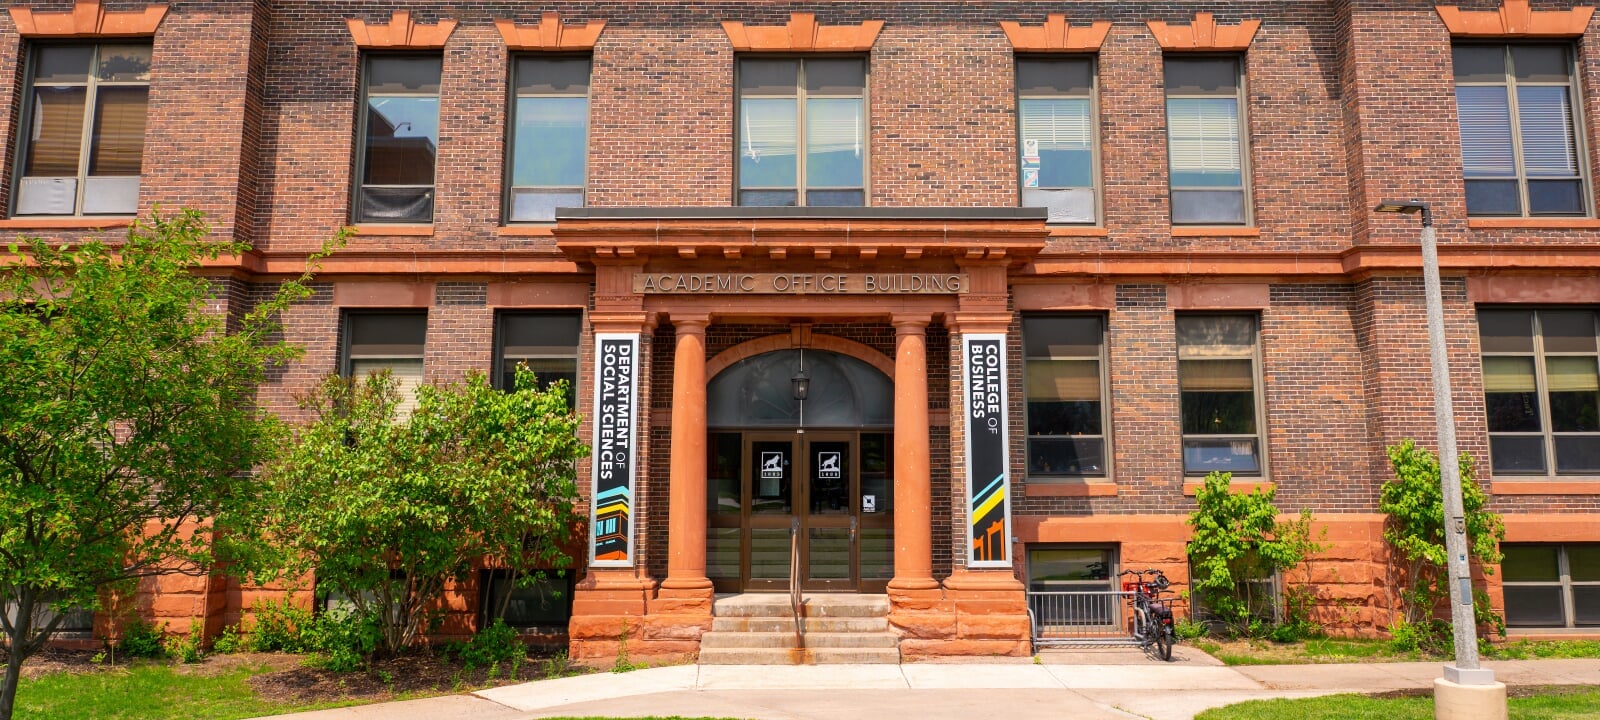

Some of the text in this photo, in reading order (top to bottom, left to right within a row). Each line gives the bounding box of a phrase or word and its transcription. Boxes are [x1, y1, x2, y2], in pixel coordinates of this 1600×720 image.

[643, 275, 961, 292] ACADEMIC OFFICE BUILDING
[601, 344, 616, 480] SOCIAL SCIENCES
[615, 344, 630, 469] DEPARTMENT OF
[971, 344, 985, 418] BUSINESS
[985, 344, 999, 435] COLLEGE OF
